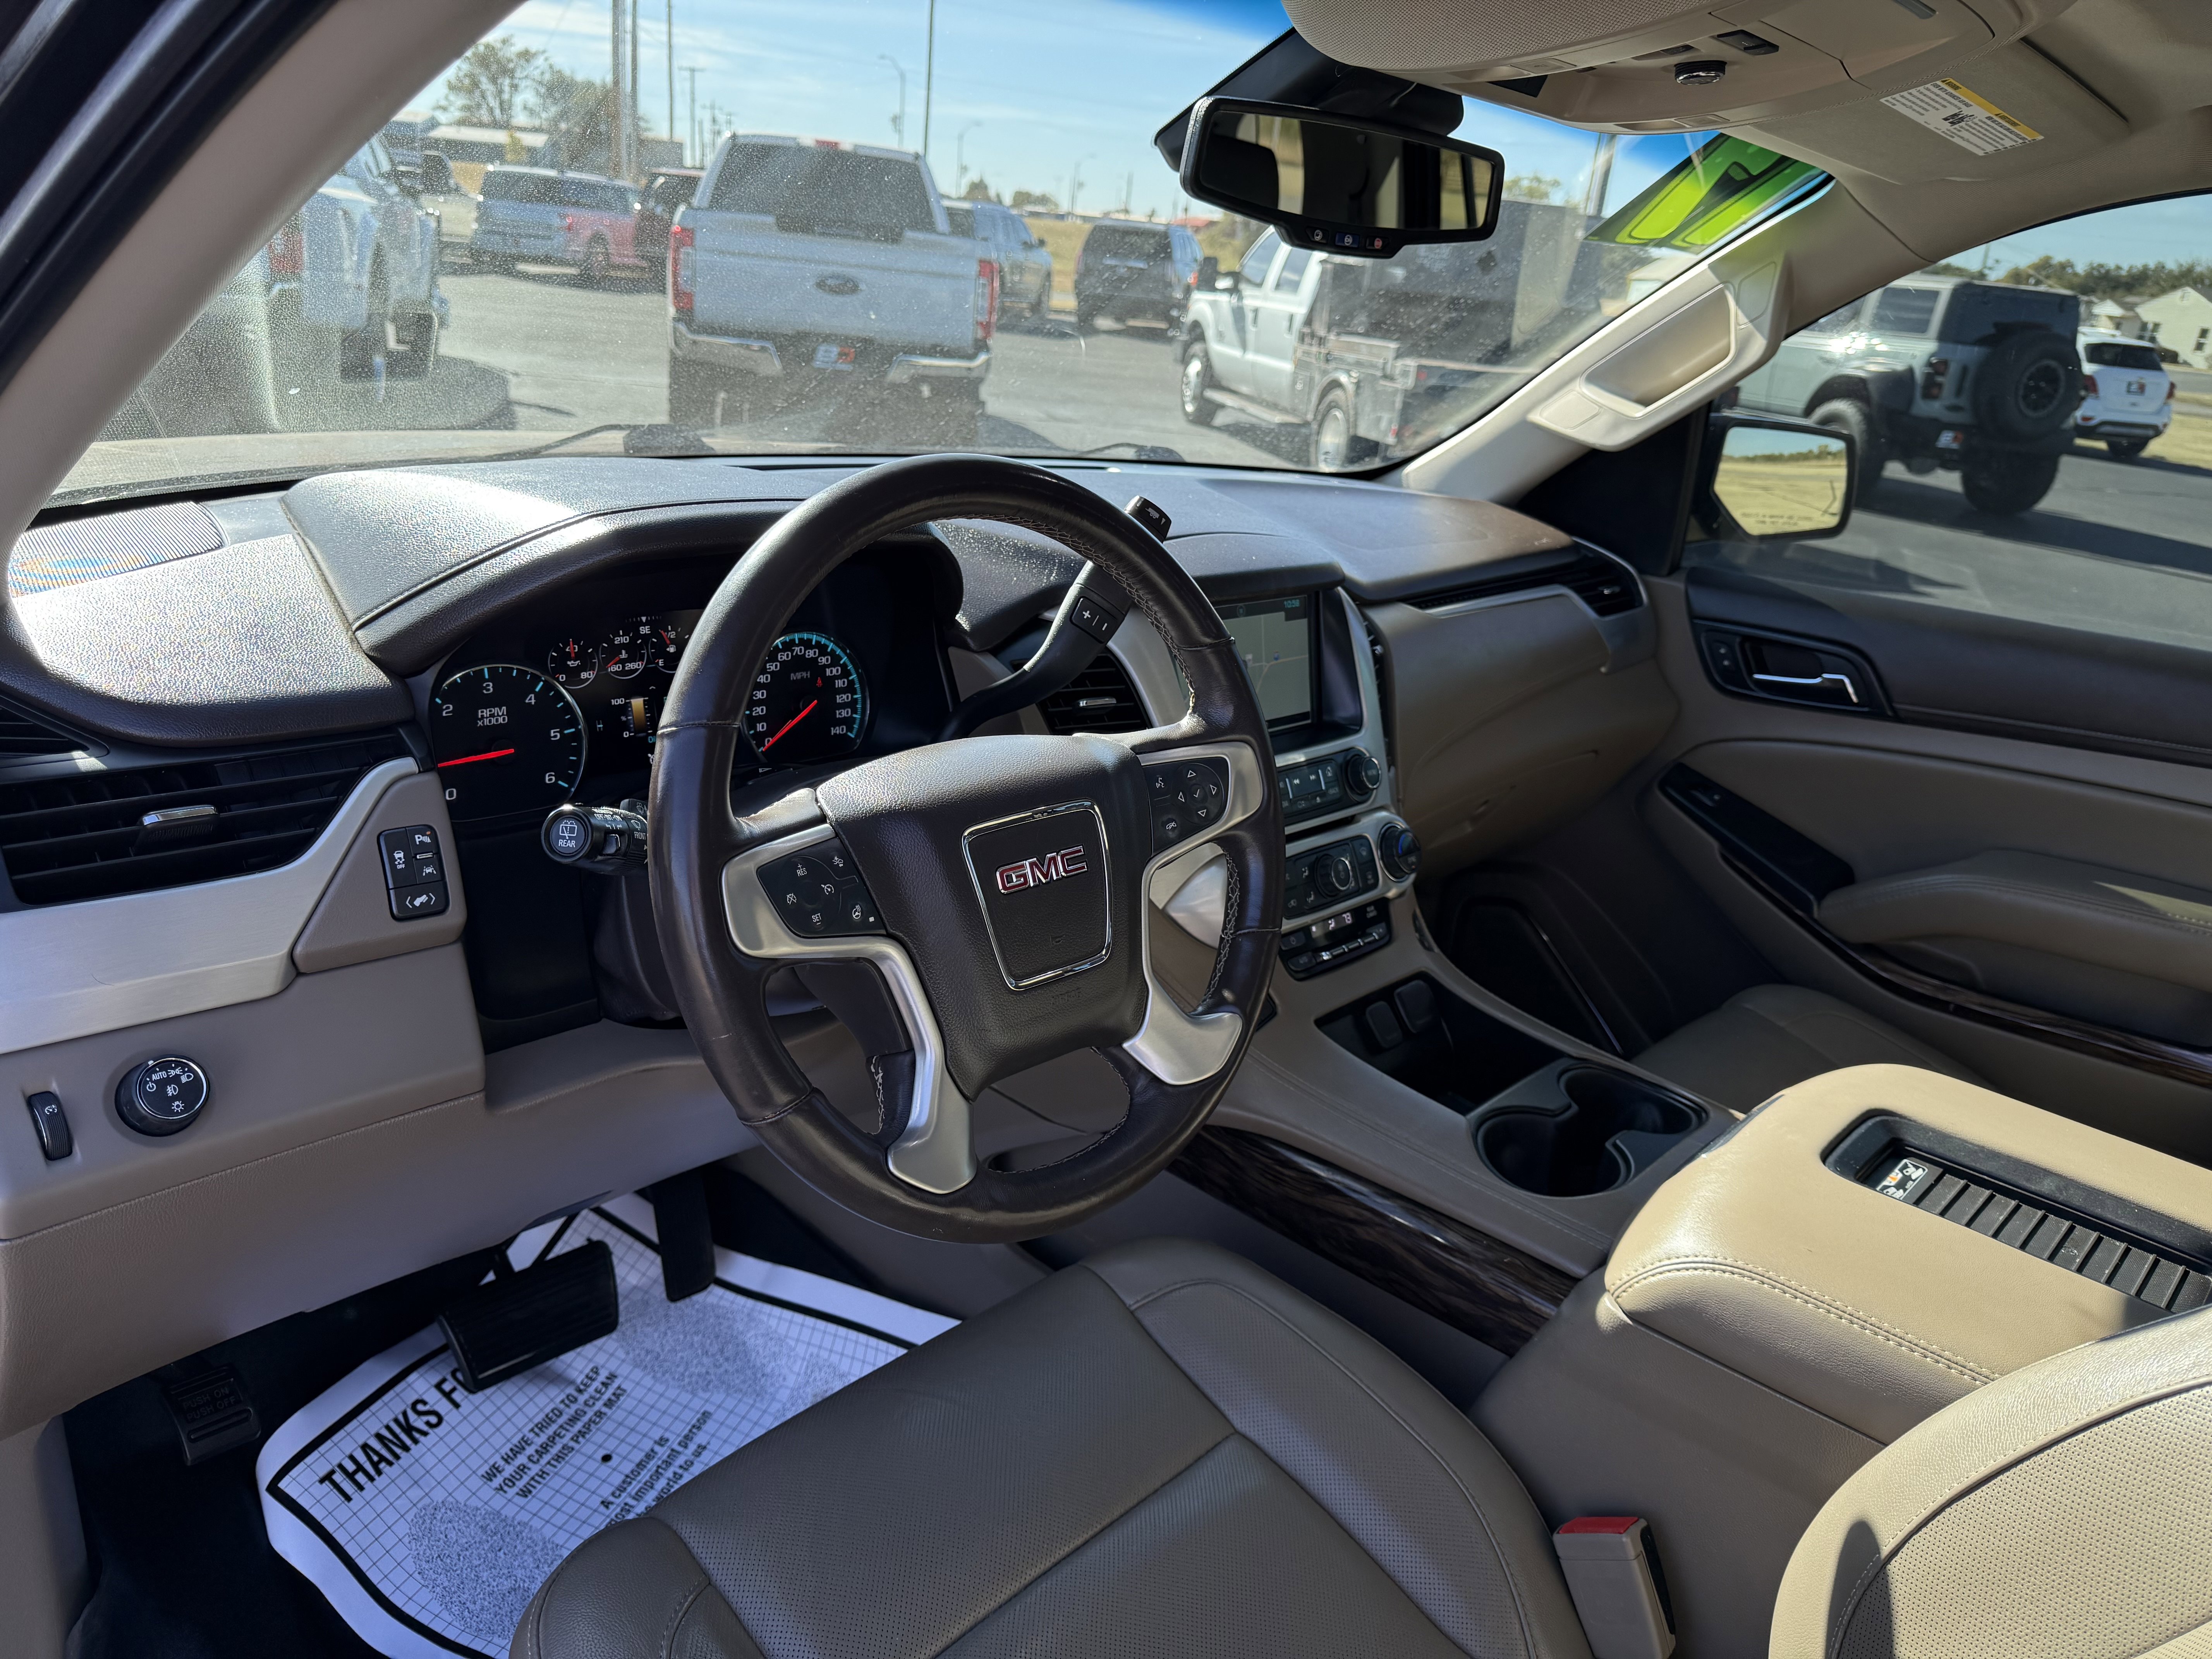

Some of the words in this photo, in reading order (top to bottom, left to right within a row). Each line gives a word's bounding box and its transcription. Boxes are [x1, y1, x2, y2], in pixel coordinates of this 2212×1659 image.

[639, 626, 651, 634] SE
[792, 646, 804, 656] 70
[805, 649, 818, 658] 80
[778, 652, 791, 661] 60
[818, 656, 831, 665] 90
[766, 662, 780, 672] 50
[826, 666, 841, 677] 100
[757, 674, 770, 684] 40
[790, 670, 810, 680] MPH
[483, 682, 493, 694] 3
[835, 678, 847, 688] 110
[525, 694, 536, 705] 4
[753, 690, 766, 699] 30
[836, 694, 851, 703] 120
[442, 704, 453, 716] 2
[477, 706, 507, 718] RPM
[752, 706, 766, 716] 20
[836, 709, 851, 719] 130
[477, 715, 508, 727] x1000
[756, 723, 766, 732] 10
[831, 726, 846, 735] 140
[550, 729, 560, 740] 5
[545, 772, 556, 783] 6
[445, 788, 457, 800] 0
[634, 831, 646, 840] FRONT
[558, 839, 575, 848] REAR
[797, 867, 807, 877] RES
[996, 844, 1089, 894] GMC
[812, 913, 821, 922] SET
[152, 1071, 167, 1081] AUTO
[183, 1394, 211, 1410] PUSH
[214, 1387, 229, 1398] ON
[186, 1405, 214, 1422] PUSH
[217, 1395, 235, 1409] OFF
[481, 1461, 505, 1483] WE
[501, 1434, 534, 1465] HAVE
[529, 1407, 563, 1437] TRIED
[560, 1393, 578, 1409] TO
[575, 1365, 600, 1395] KEEP
[495, 1463, 531, 1494] YOUR
[527, 1407, 587, 1465] CARPETING
[583, 1371, 618, 1408] CLEAN
[516, 1468, 550, 1499] WITH
[545, 1443, 575, 1469] THIS
[570, 1409, 608, 1445] PAPER
[603, 1385, 627, 1410] MAT
[318, 1398, 443, 1503] THANKS
[631, 1448, 680, 1502] important
[678, 1410, 711, 1449] person
[601, 1499, 614, 1510] A
[611, 1447, 658, 1499] customer
[654, 1435, 670, 1447] is
[652, 1471, 683, 1503] world
[679, 1459, 694, 1471] to
